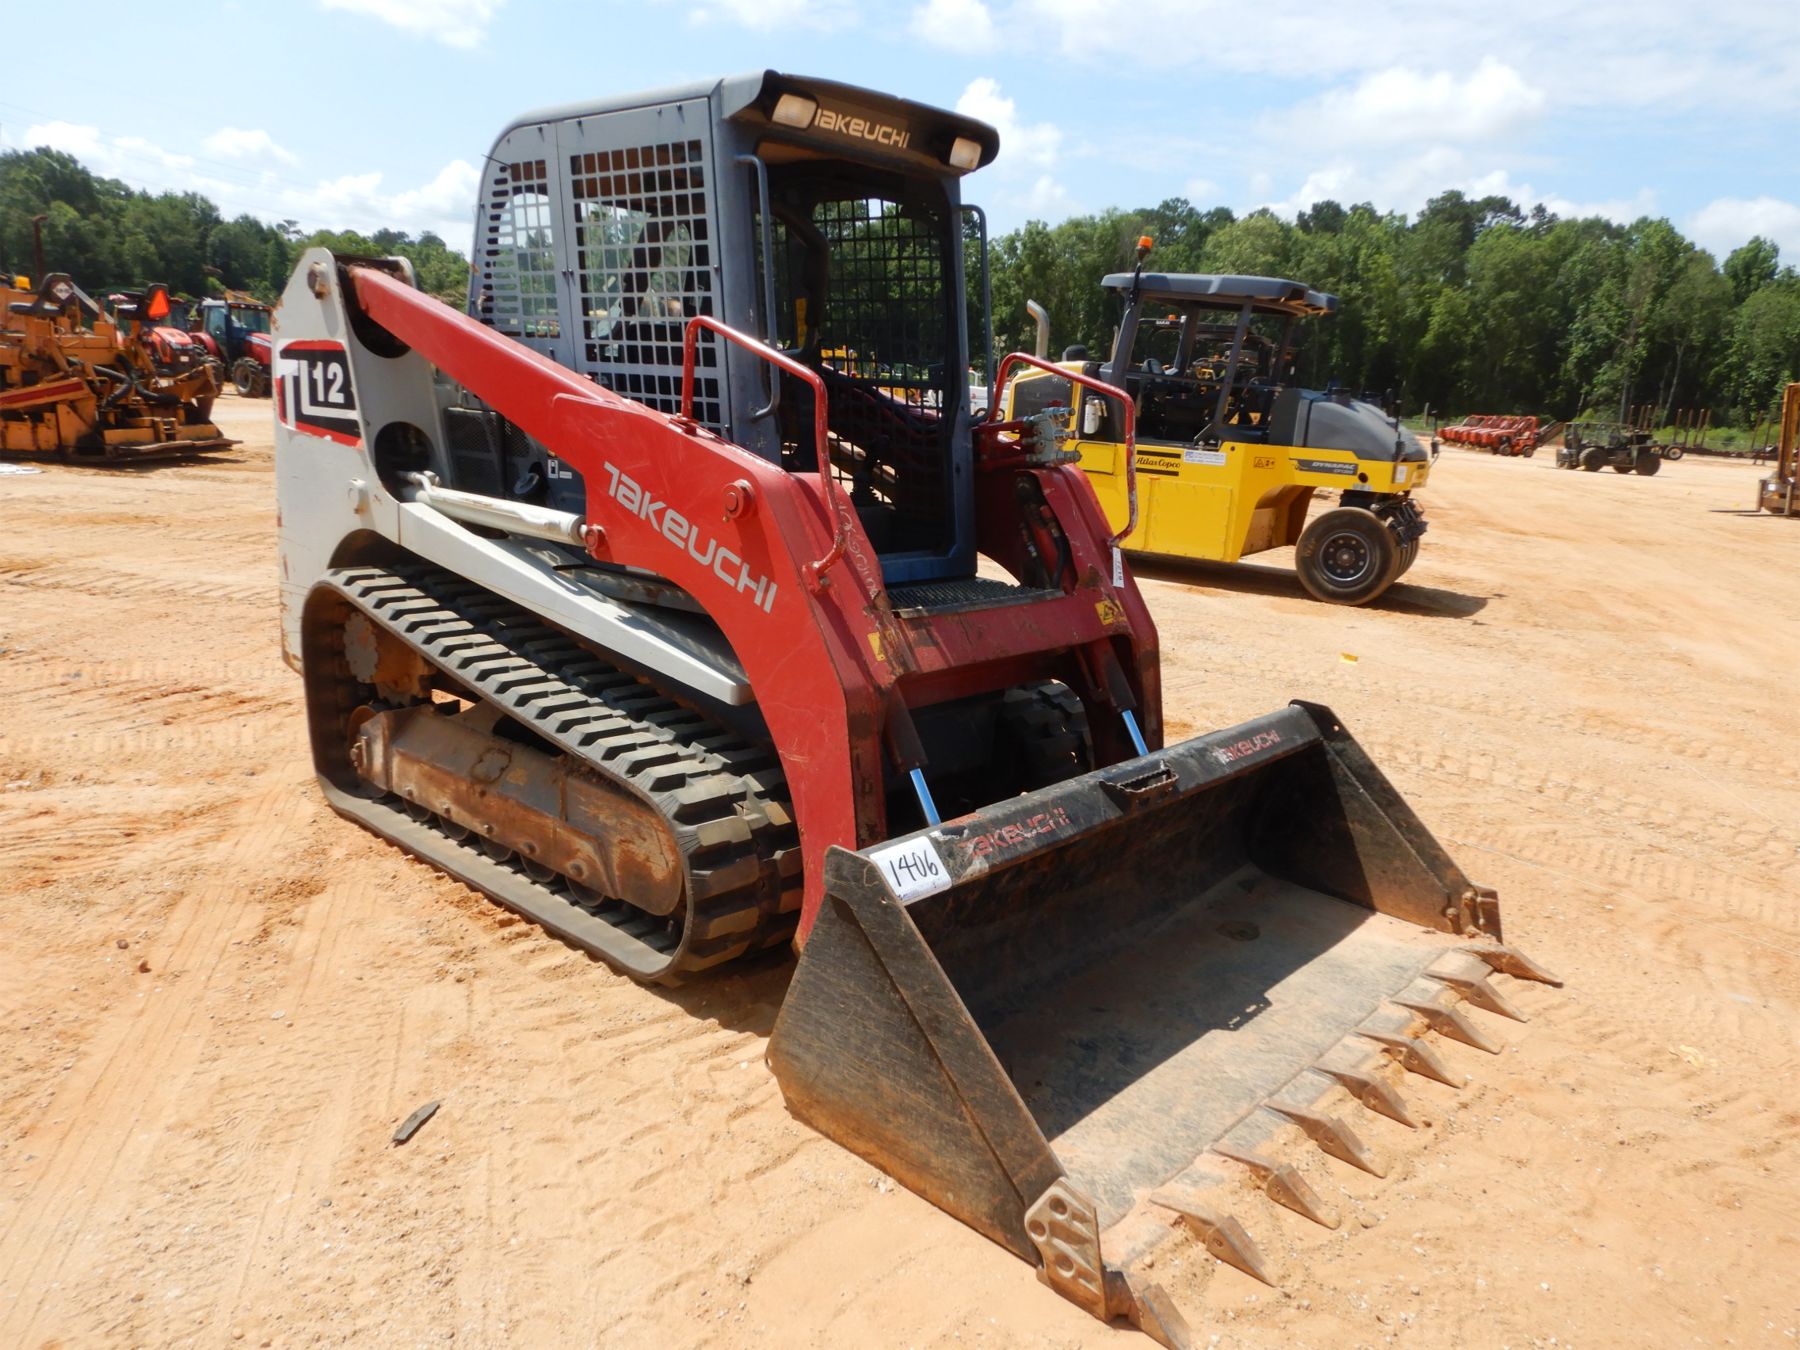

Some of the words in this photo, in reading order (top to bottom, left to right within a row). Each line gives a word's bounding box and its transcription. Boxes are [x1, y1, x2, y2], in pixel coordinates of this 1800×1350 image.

[1136, 456, 1158, 467] Atlas
[1158, 458, 1181, 469] Copco
[889, 848, 939, 887] 1406
